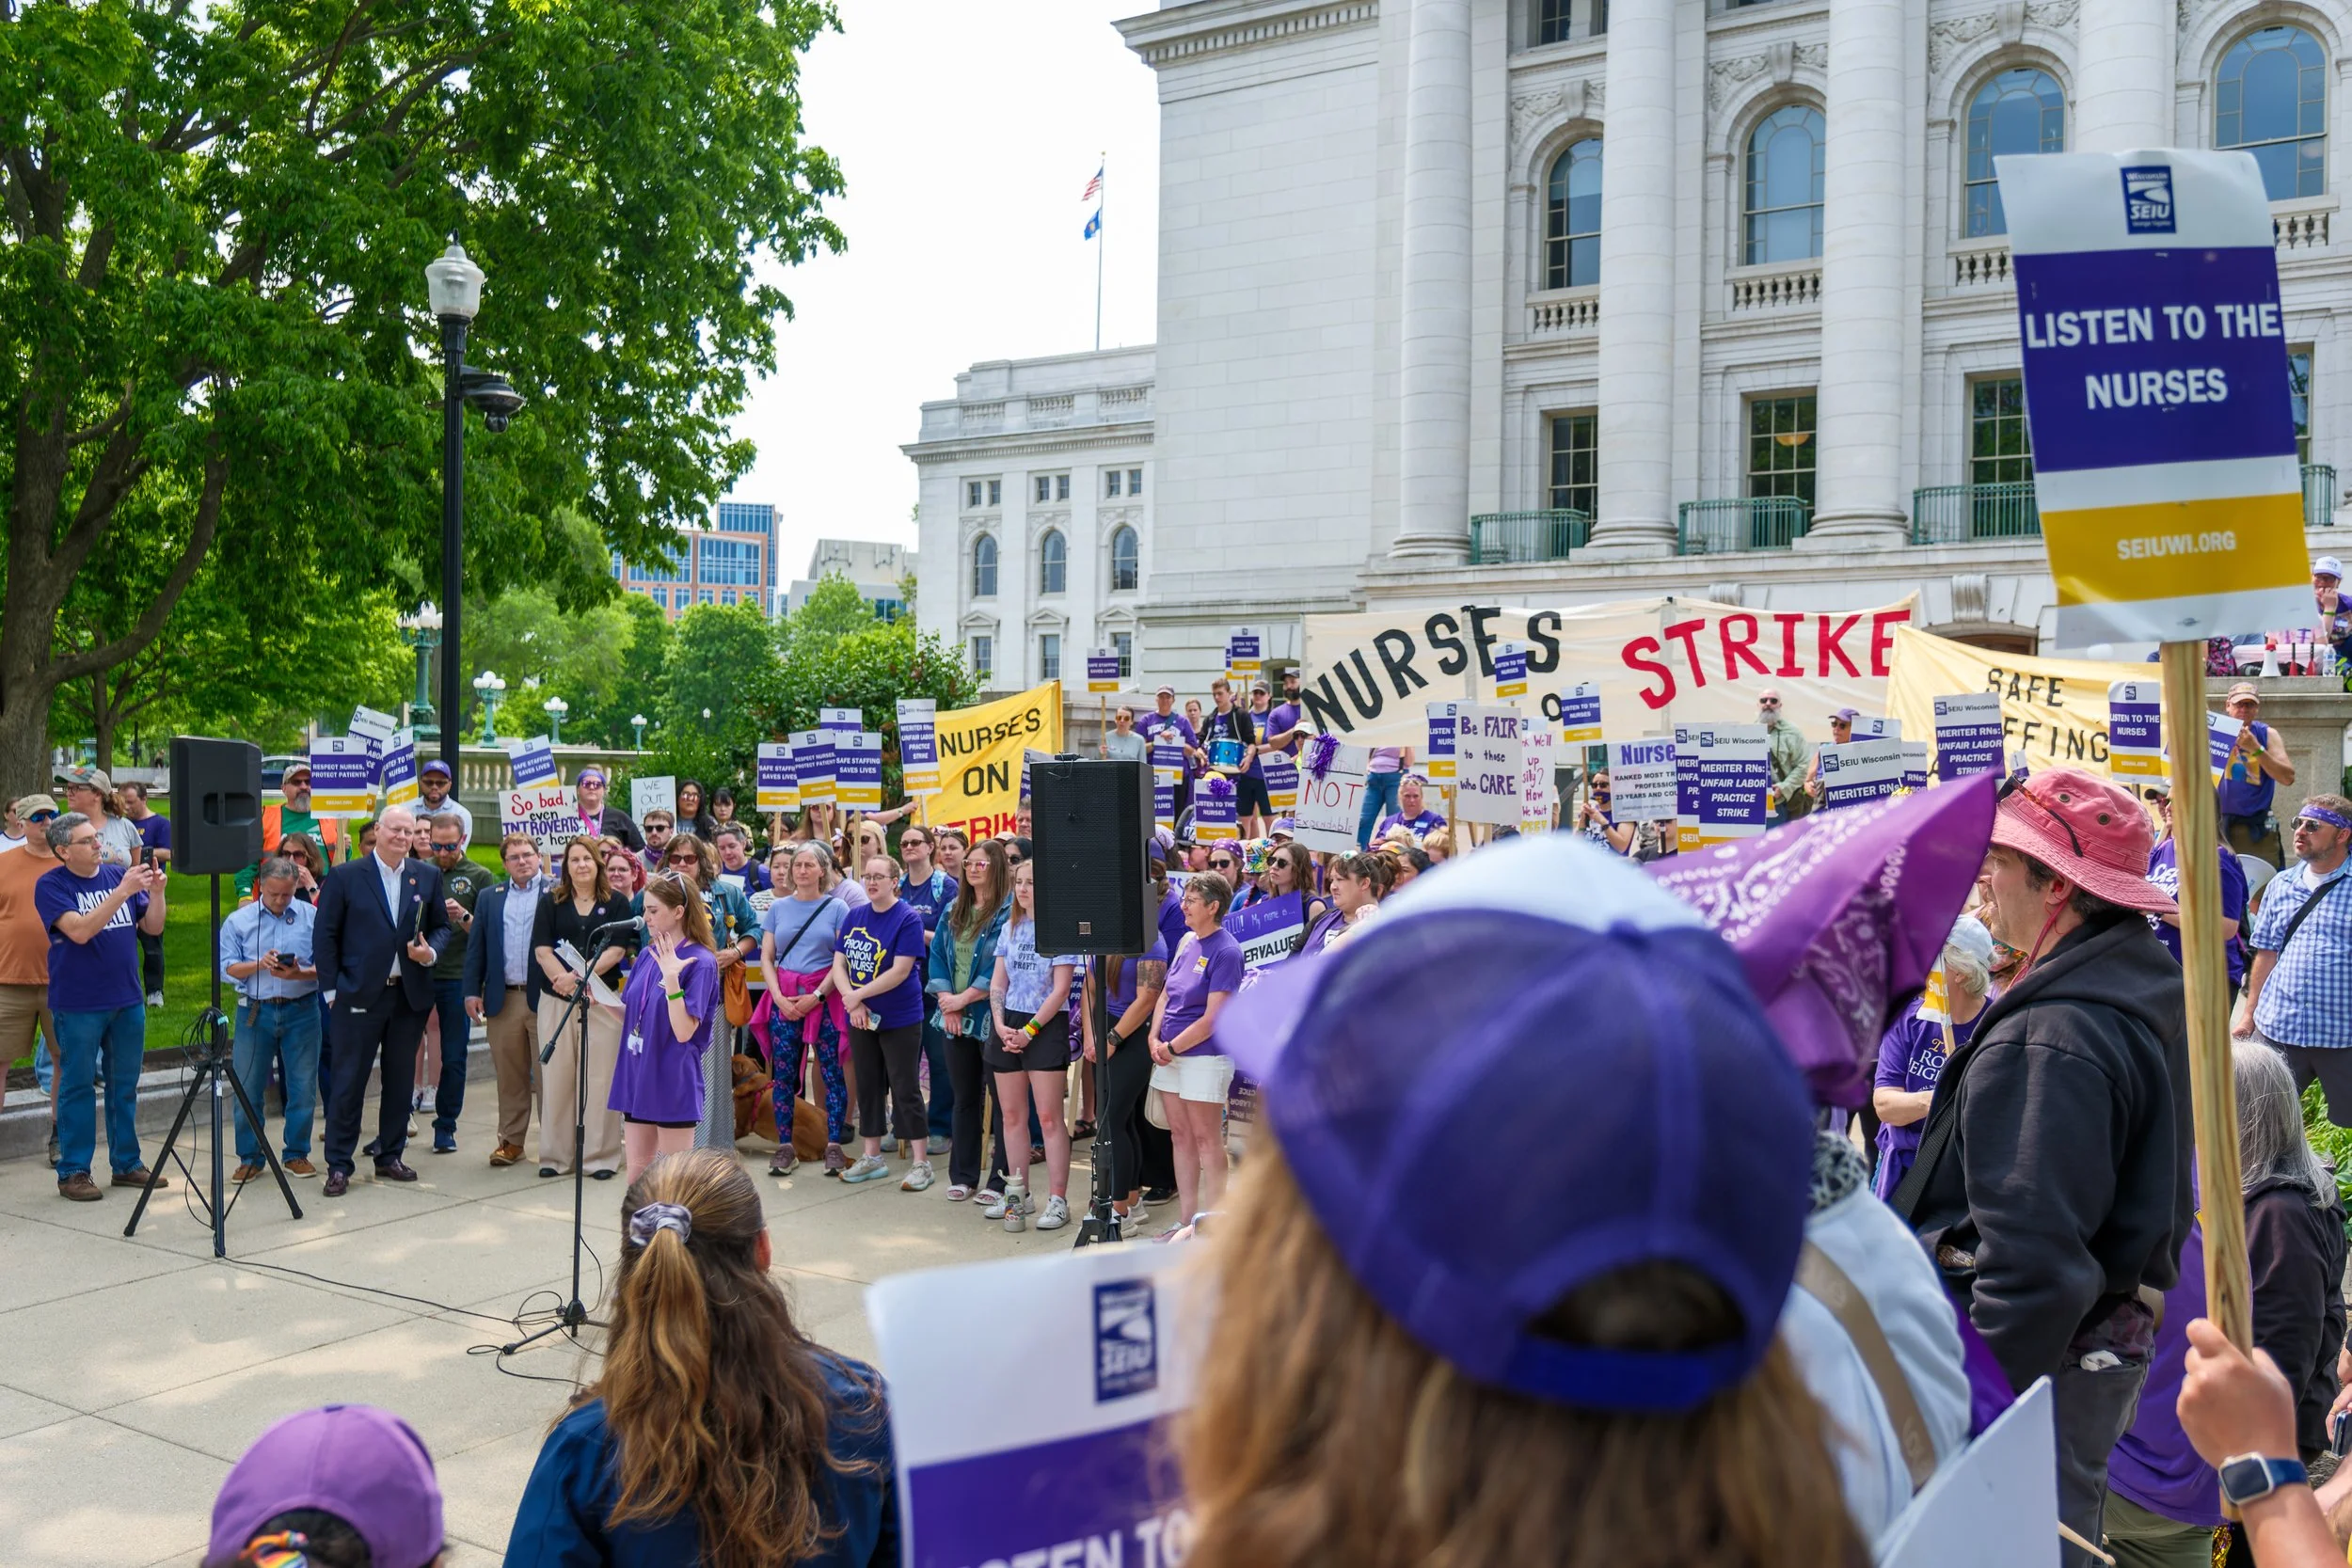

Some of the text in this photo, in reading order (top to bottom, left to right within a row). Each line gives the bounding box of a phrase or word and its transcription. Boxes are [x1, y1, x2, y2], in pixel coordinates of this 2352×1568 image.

[2130, 204, 2170, 219] SEIU
[2025, 302, 2281, 349] LISTEN TO THE
[2085, 368, 2229, 410] NURSES
[2116, 530, 2237, 561] SEIUWI.ORG
[1621, 609, 1912, 710] STRIKE
[1300, 606, 1562, 733] NURSES
[1986, 668, 2065, 707] SAFE
[1965, 704, 2000, 712] Wisconsin
[2110, 714, 2130, 722] LISTEN
[2144, 715, 2160, 723] THE
[940, 707, 1041, 758] NURSES
[1461, 716, 1518, 739] Be FAIR
[1937, 727, 2001, 737] MERITER RNs:
[2117, 727, 2147, 736] NURSES
[1938, 739, 2003, 751] UNFAIR LABOR
[2004, 716, 2109, 763] FFING
[2210, 740, 2230, 751] RSES,
[398, 754, 405, 763] TO
[405, 752, 414, 762] THE
[1464, 750, 1505, 763] to those
[1840, 752, 1900, 768] SEIU Wisconsin
[1949, 752, 1993, 763] PRACTICE
[2209, 750, 2230, 758] IENTS
[514, 754, 551, 770] SAFE STAFFING
[795, 761, 816, 769] PROTECT
[1527, 757, 1539, 770] up
[1677, 759, 1698, 768] MERI
[1701, 764, 1765, 773] MERITER RNs:
[518, 762, 550, 777] SAVES LIVES
[1956, 766, 1988, 775] STRIKE
[962, 760, 1009, 797] ON
[1700, 779, 1766, 788] UNFAIR LABOR
[1907, 773, 1927, 782] RNs:
[644, 781, 661, 790] WE
[1460, 773, 1517, 796] who CARE
[641, 793, 666, 805] OUT
[1304, 779, 1363, 810] NOT
[1526, 789, 1543, 801] How
[1711, 793, 1756, 802] PRACTICE
[1828, 785, 1877, 801] MERITER
[511, 794, 533, 816] So
[530, 811, 558, 821] even
[1717, 808, 1750, 817] STRIKE
[503, 816, 580, 836] INTROVERTS
[844, 939, 872, 952] PROUD
[1244, 933, 1301, 964] ERVALUE
[847, 949, 871, 961] UNION
[850, 959, 875, 973] NURSE
